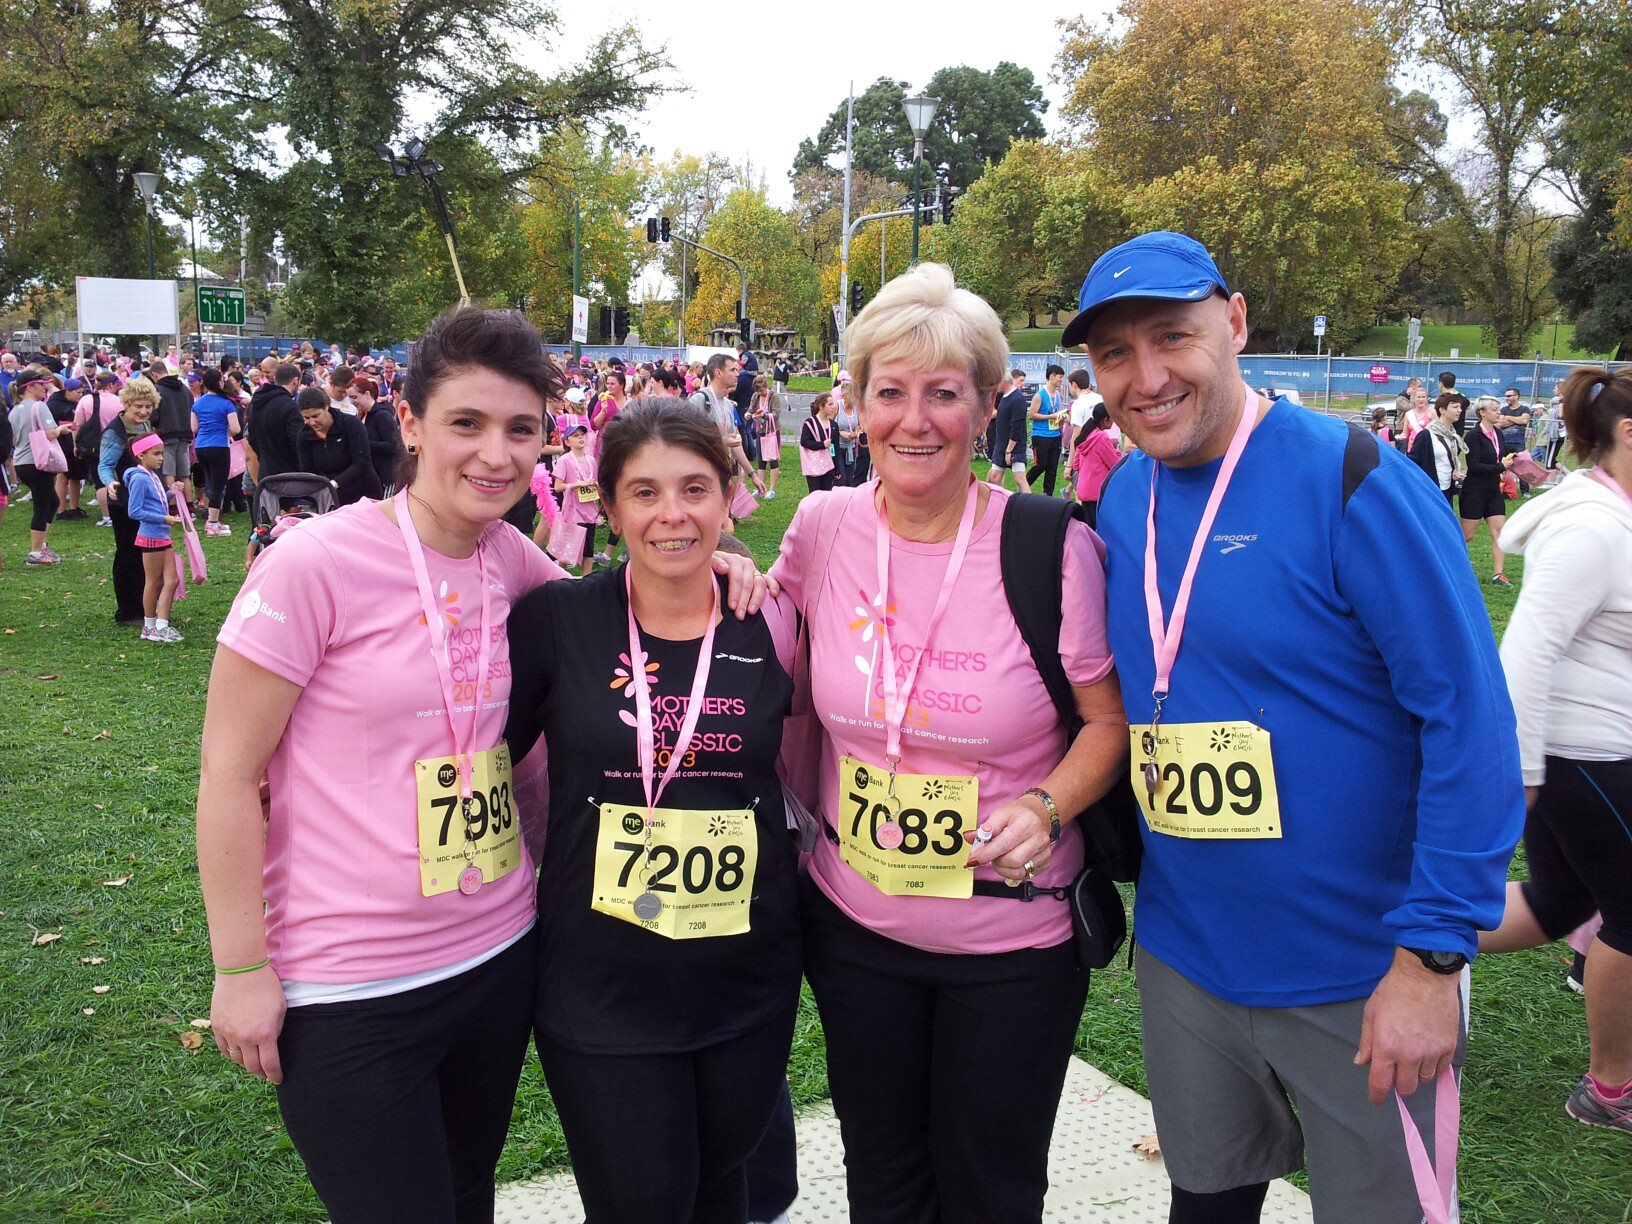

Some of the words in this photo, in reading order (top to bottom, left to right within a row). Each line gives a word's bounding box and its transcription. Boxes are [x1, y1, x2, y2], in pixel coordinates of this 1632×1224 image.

[1212, 534, 1258, 542] BROOKS
[260, 602, 287, 624] Bank
[450, 646, 481, 665] DAY
[729, 655, 763, 663] BROOKS
[452, 682, 494, 702] 203
[416, 709, 434, 718] Walk
[828, 712, 847, 723] Walk
[858, 719, 872, 727] run
[873, 720, 885, 729] for
[914, 729, 946, 741] cancer
[948, 735, 989, 745] research
[604, 770, 622, 779] Walk
[624, 771, 631, 779] or
[683, 769, 709, 778] cancer
[711, 769, 744, 779] research
[431, 781, 512, 847] 7993
[849, 791, 964, 856] 7083
[436, 855, 451, 863] MDC
[613, 841, 746, 895] 7208
[905, 880, 924, 889] 7083
[610, 897, 626, 905] MDC
[711, 900, 735, 908] research
[640, 920, 659, 930] 7208
[688, 921, 707, 930] 7208
